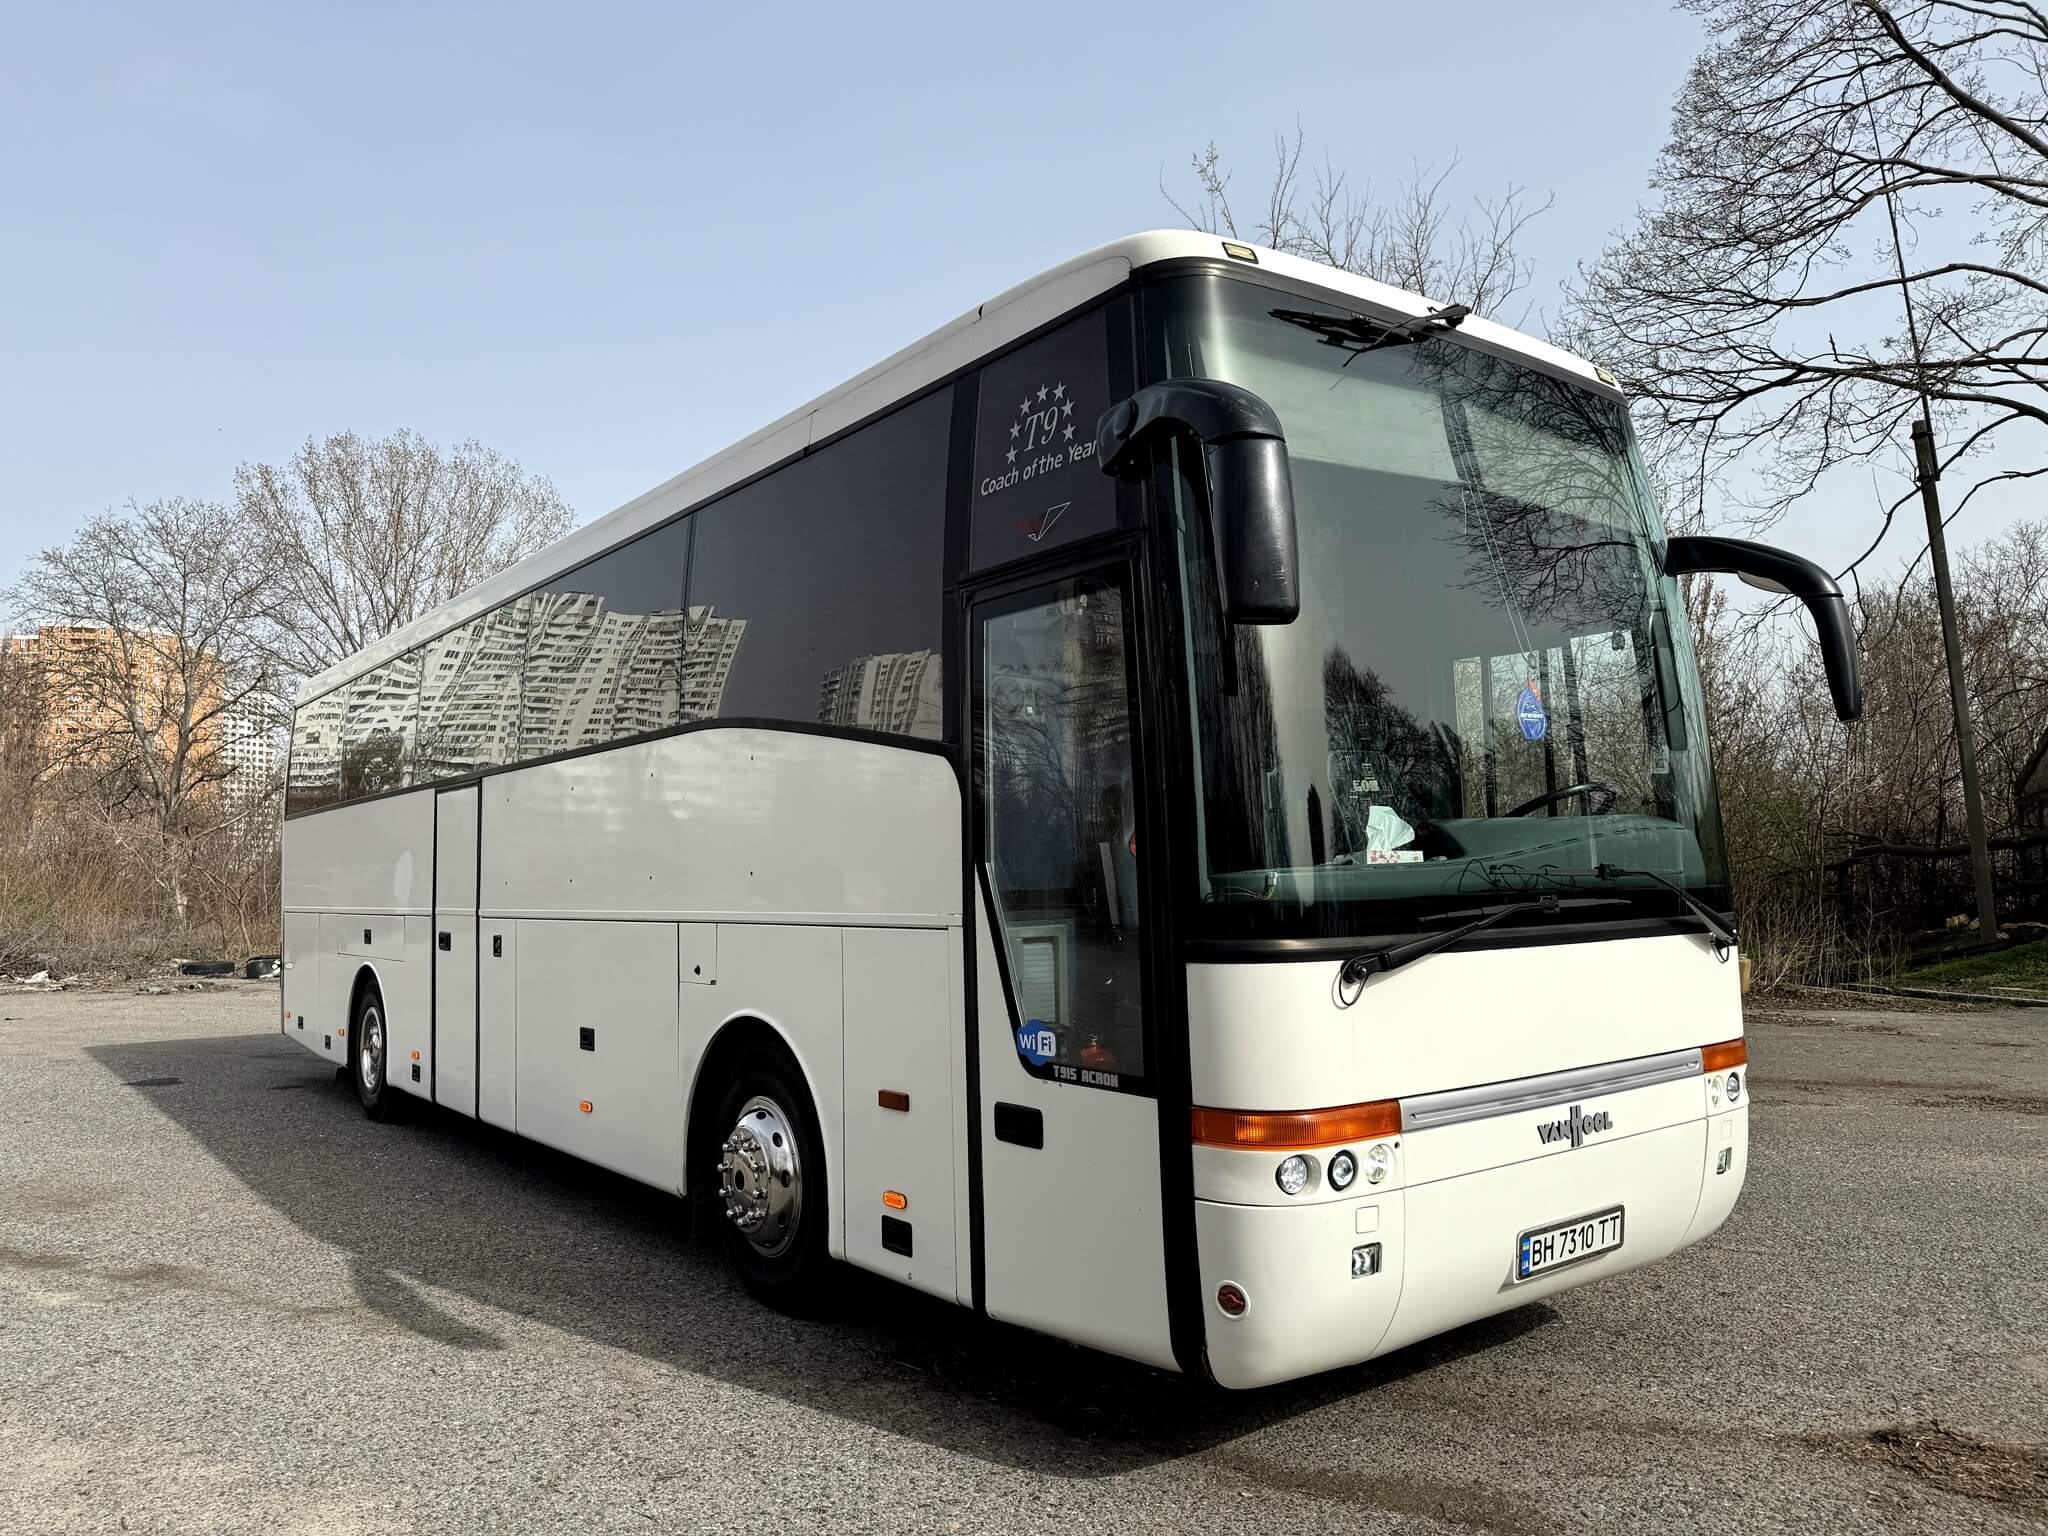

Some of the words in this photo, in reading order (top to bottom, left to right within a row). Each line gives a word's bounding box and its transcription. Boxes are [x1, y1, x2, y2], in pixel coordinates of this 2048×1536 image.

[1024, 406, 1059, 452] T9
[981, 466, 1019, 497] Coach
[1023, 457, 1038, 480] of
[1040, 453, 1063, 474] the
[1068, 440, 1098, 463] Year
[1053, 1064, 1077, 1081] T915
[1081, 1069, 1119, 1088] ACRON
[1532, 1234, 1554, 1267] BH
[1560, 1223, 1594, 1258] 7310
[1599, 1214, 1620, 1245] TT
